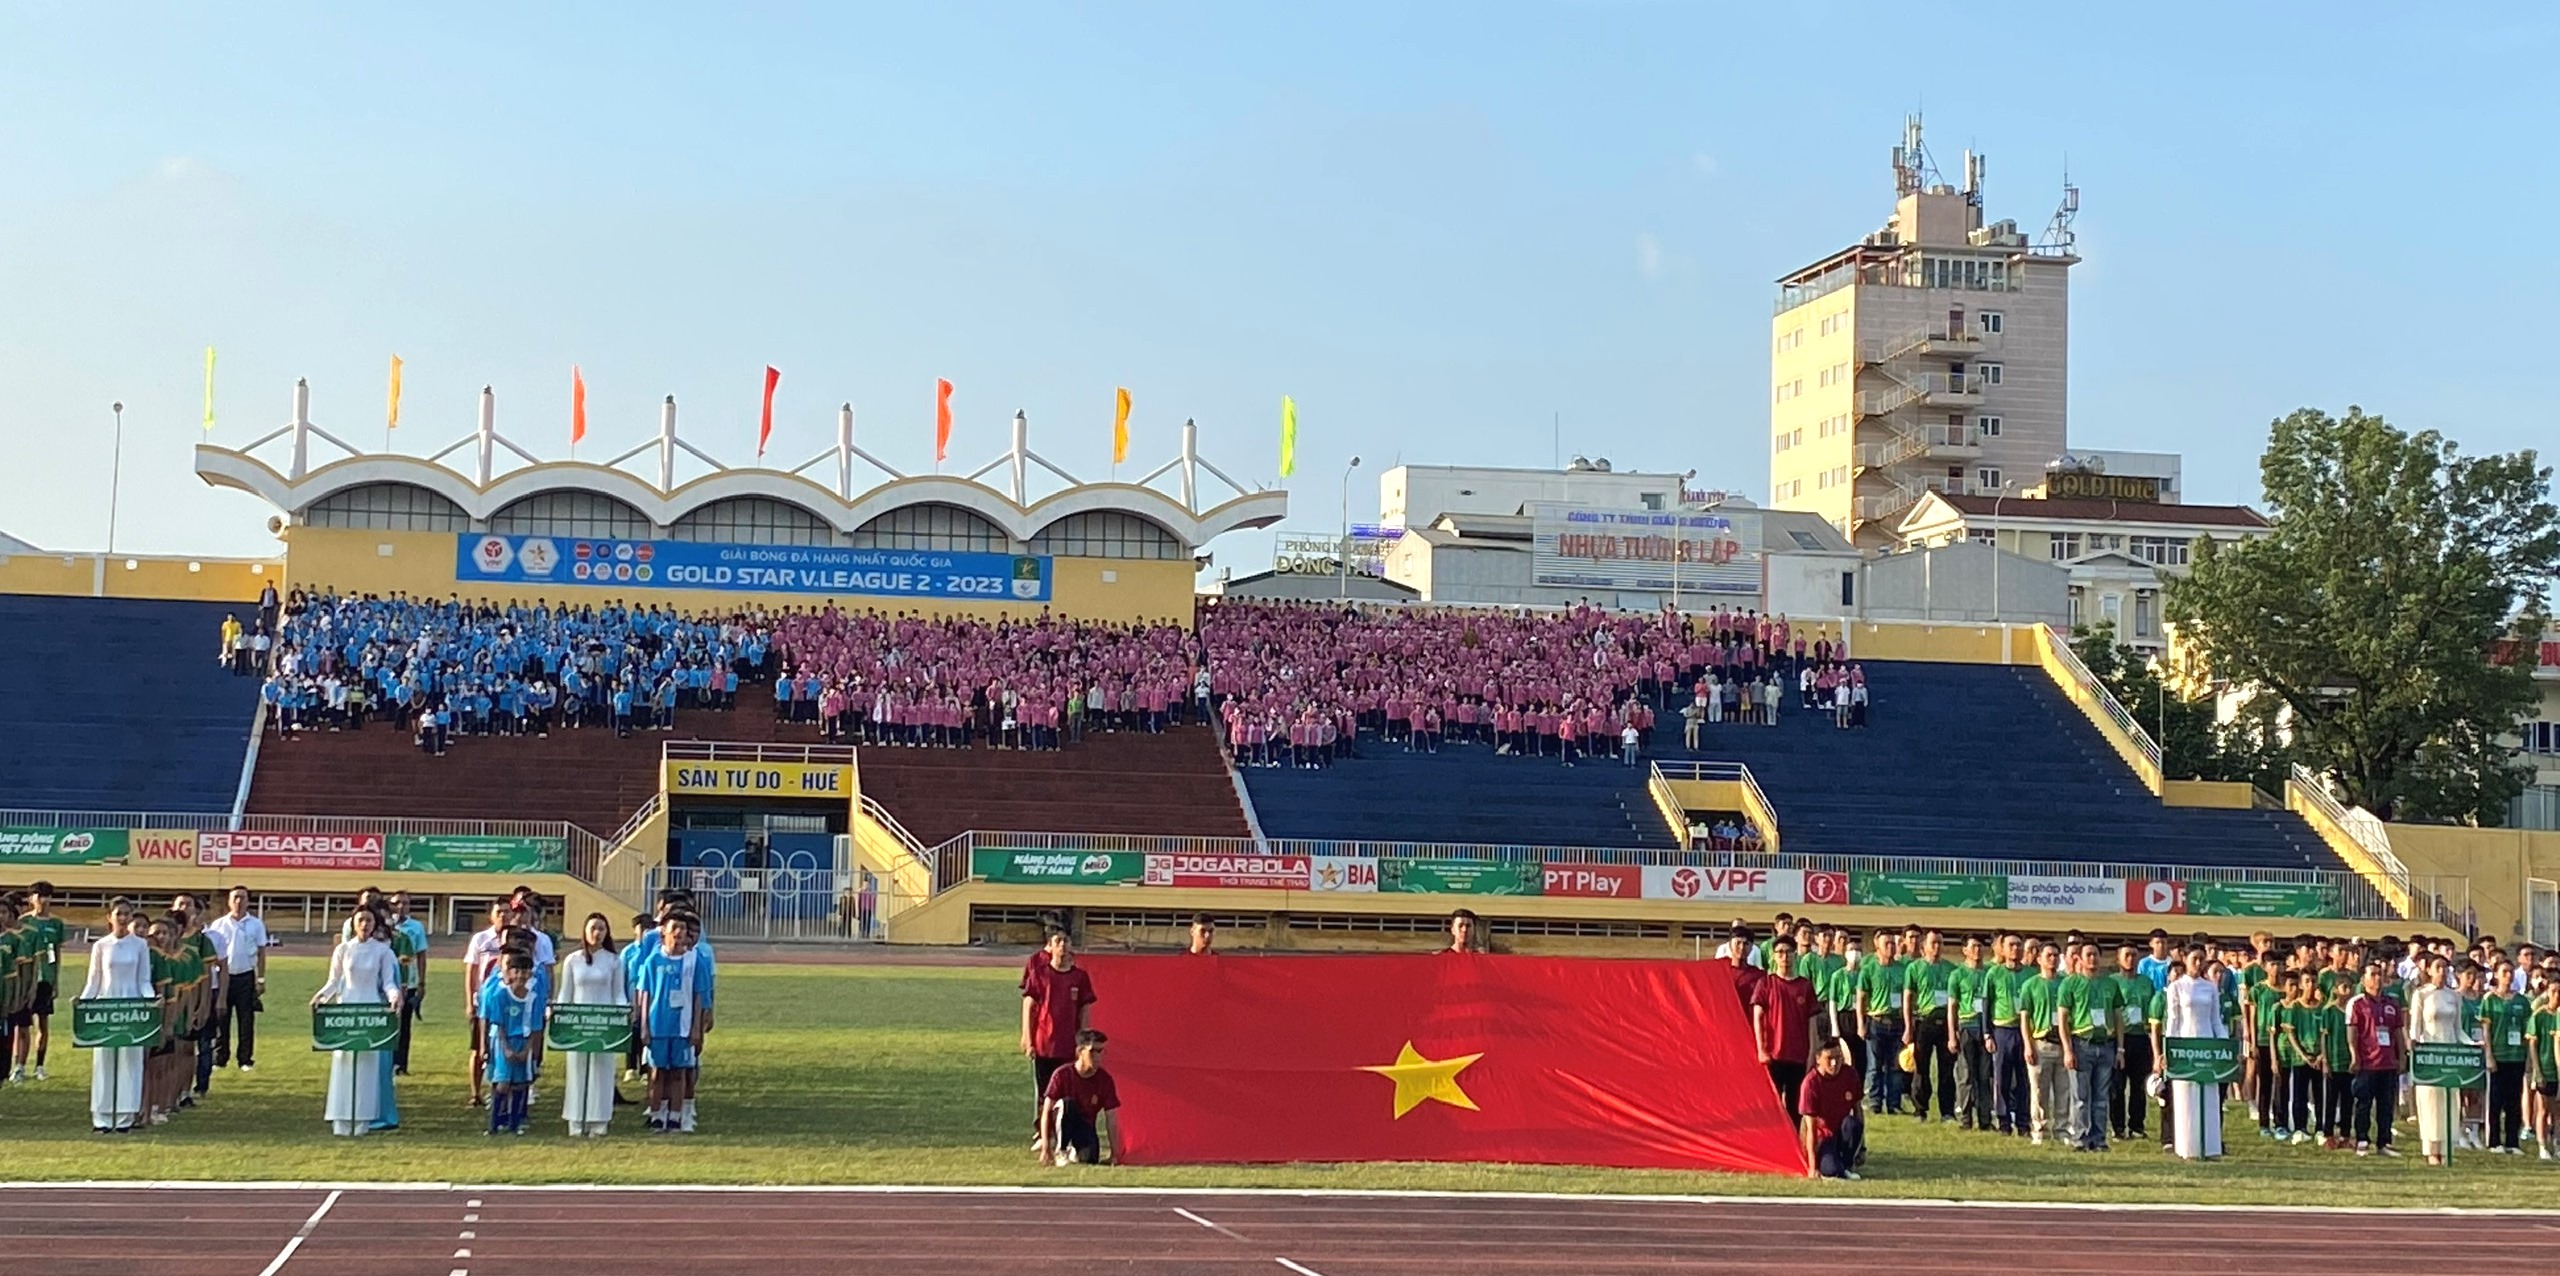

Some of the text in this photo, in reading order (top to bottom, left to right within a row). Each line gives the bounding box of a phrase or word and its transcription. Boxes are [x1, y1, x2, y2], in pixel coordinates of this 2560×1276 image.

[2047, 475, 2105, 498] GOLD
[720, 548, 953, 568] GIẢI BÓNG ĐÁ HẠNG NHẤT QUỐC GIA
[666, 565, 732, 584] GOLD
[736, 567, 796, 587] STAR
[799, 569, 913, 591] V.LEAGUE
[916, 574, 931, 591] 2
[946, 576, 1004, 594] 2023
[678, 764, 718, 788] SÂN
[725, 769, 751, 793] TỰ
[756, 771, 781, 789] DO
[802, 767, 841, 791] HUẾ
[231, 835, 380, 853] JOGARBOLA
[1047, 865, 1076, 876] NAM
[1174, 856, 1309, 874] JOGARBOLA
[1347, 863, 1376, 885] BIA
[1576, 870, 1622, 894] Play
[1704, 868, 1767, 893] VPF
[85, 1009, 150, 1023] LAI CHÂU
[325, 1016, 388, 1027] KON TUM
[2416, 1053, 2480, 1067] KIÊN GIANG
